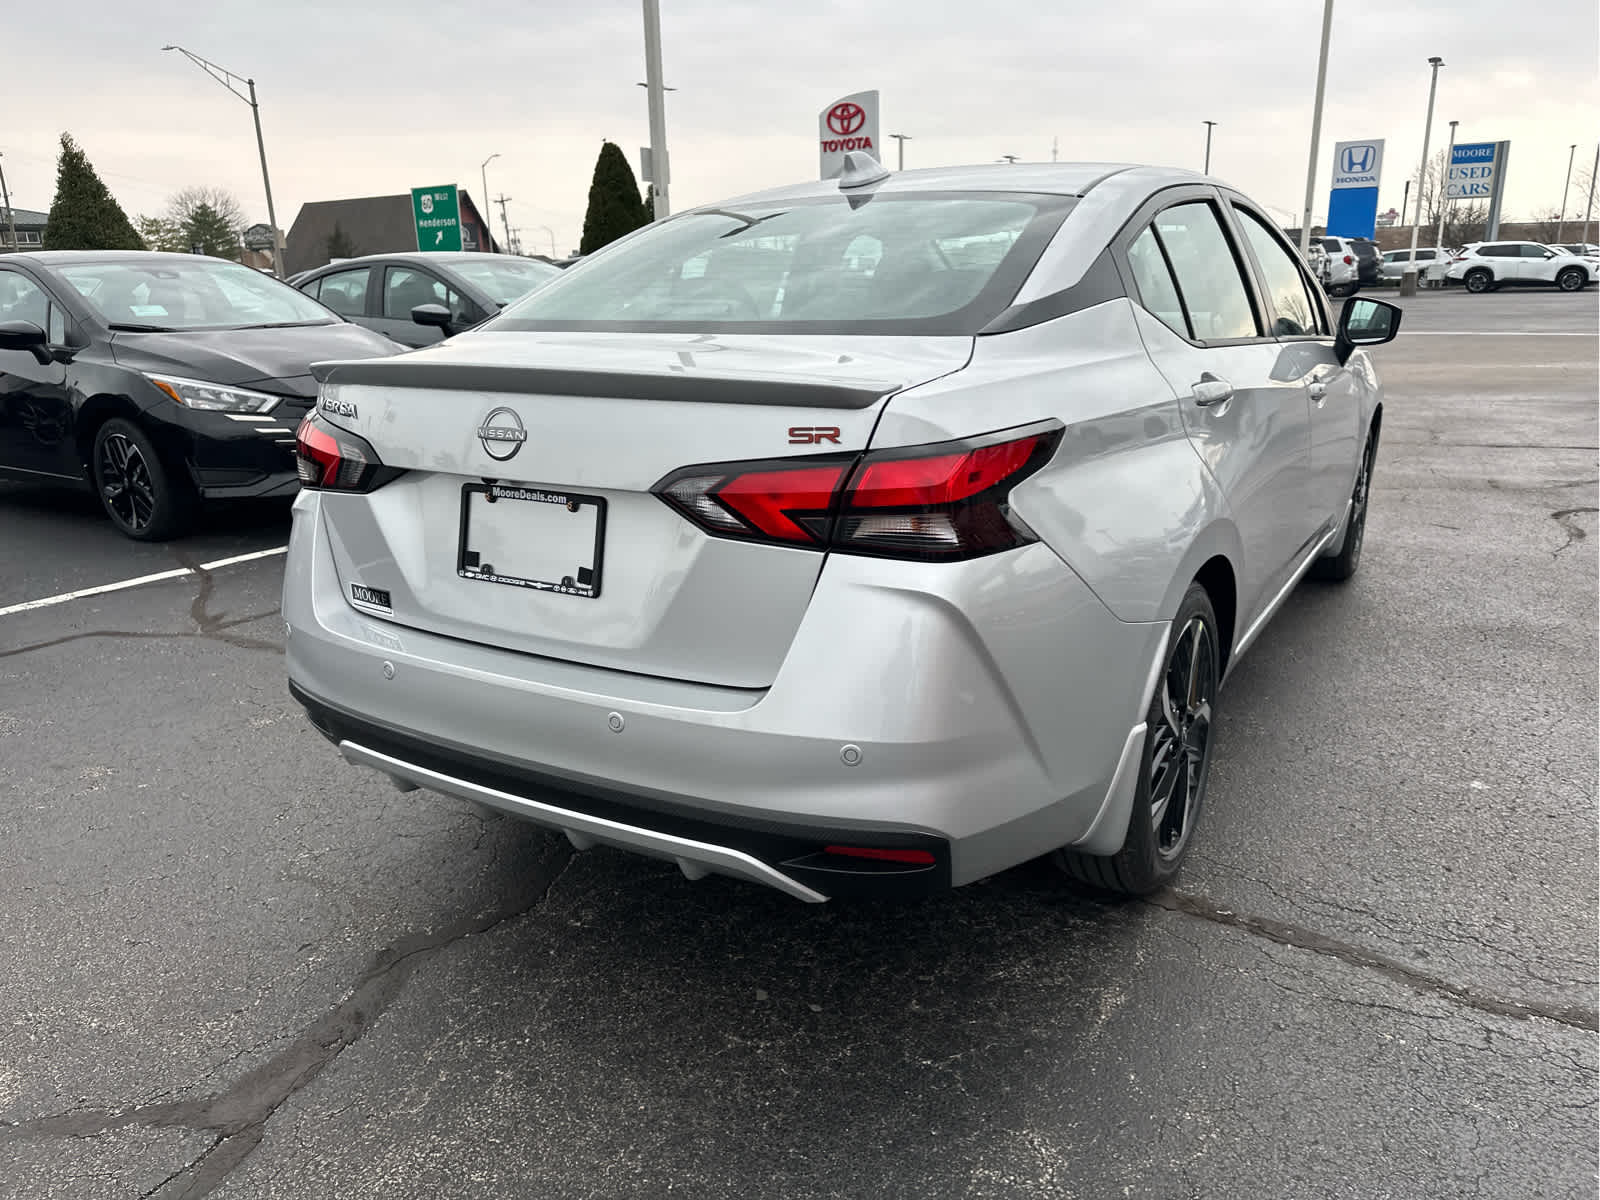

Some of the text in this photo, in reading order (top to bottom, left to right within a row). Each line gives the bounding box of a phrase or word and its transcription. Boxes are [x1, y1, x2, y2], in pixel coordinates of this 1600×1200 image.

[821, 136, 873, 153] TOYOTA
[1454, 149, 1492, 158] MOORE
[1336, 176, 1376, 184] HONDA
[1449, 167, 1492, 180] USED
[1447, 183, 1490, 196] CARS
[419, 218, 456, 227] Henderson
[321, 399, 359, 420] VERSA
[479, 428, 524, 439] NISSAN
[788, 427, 842, 444] SR
[492, 487, 567, 504] MooreDeals.com
